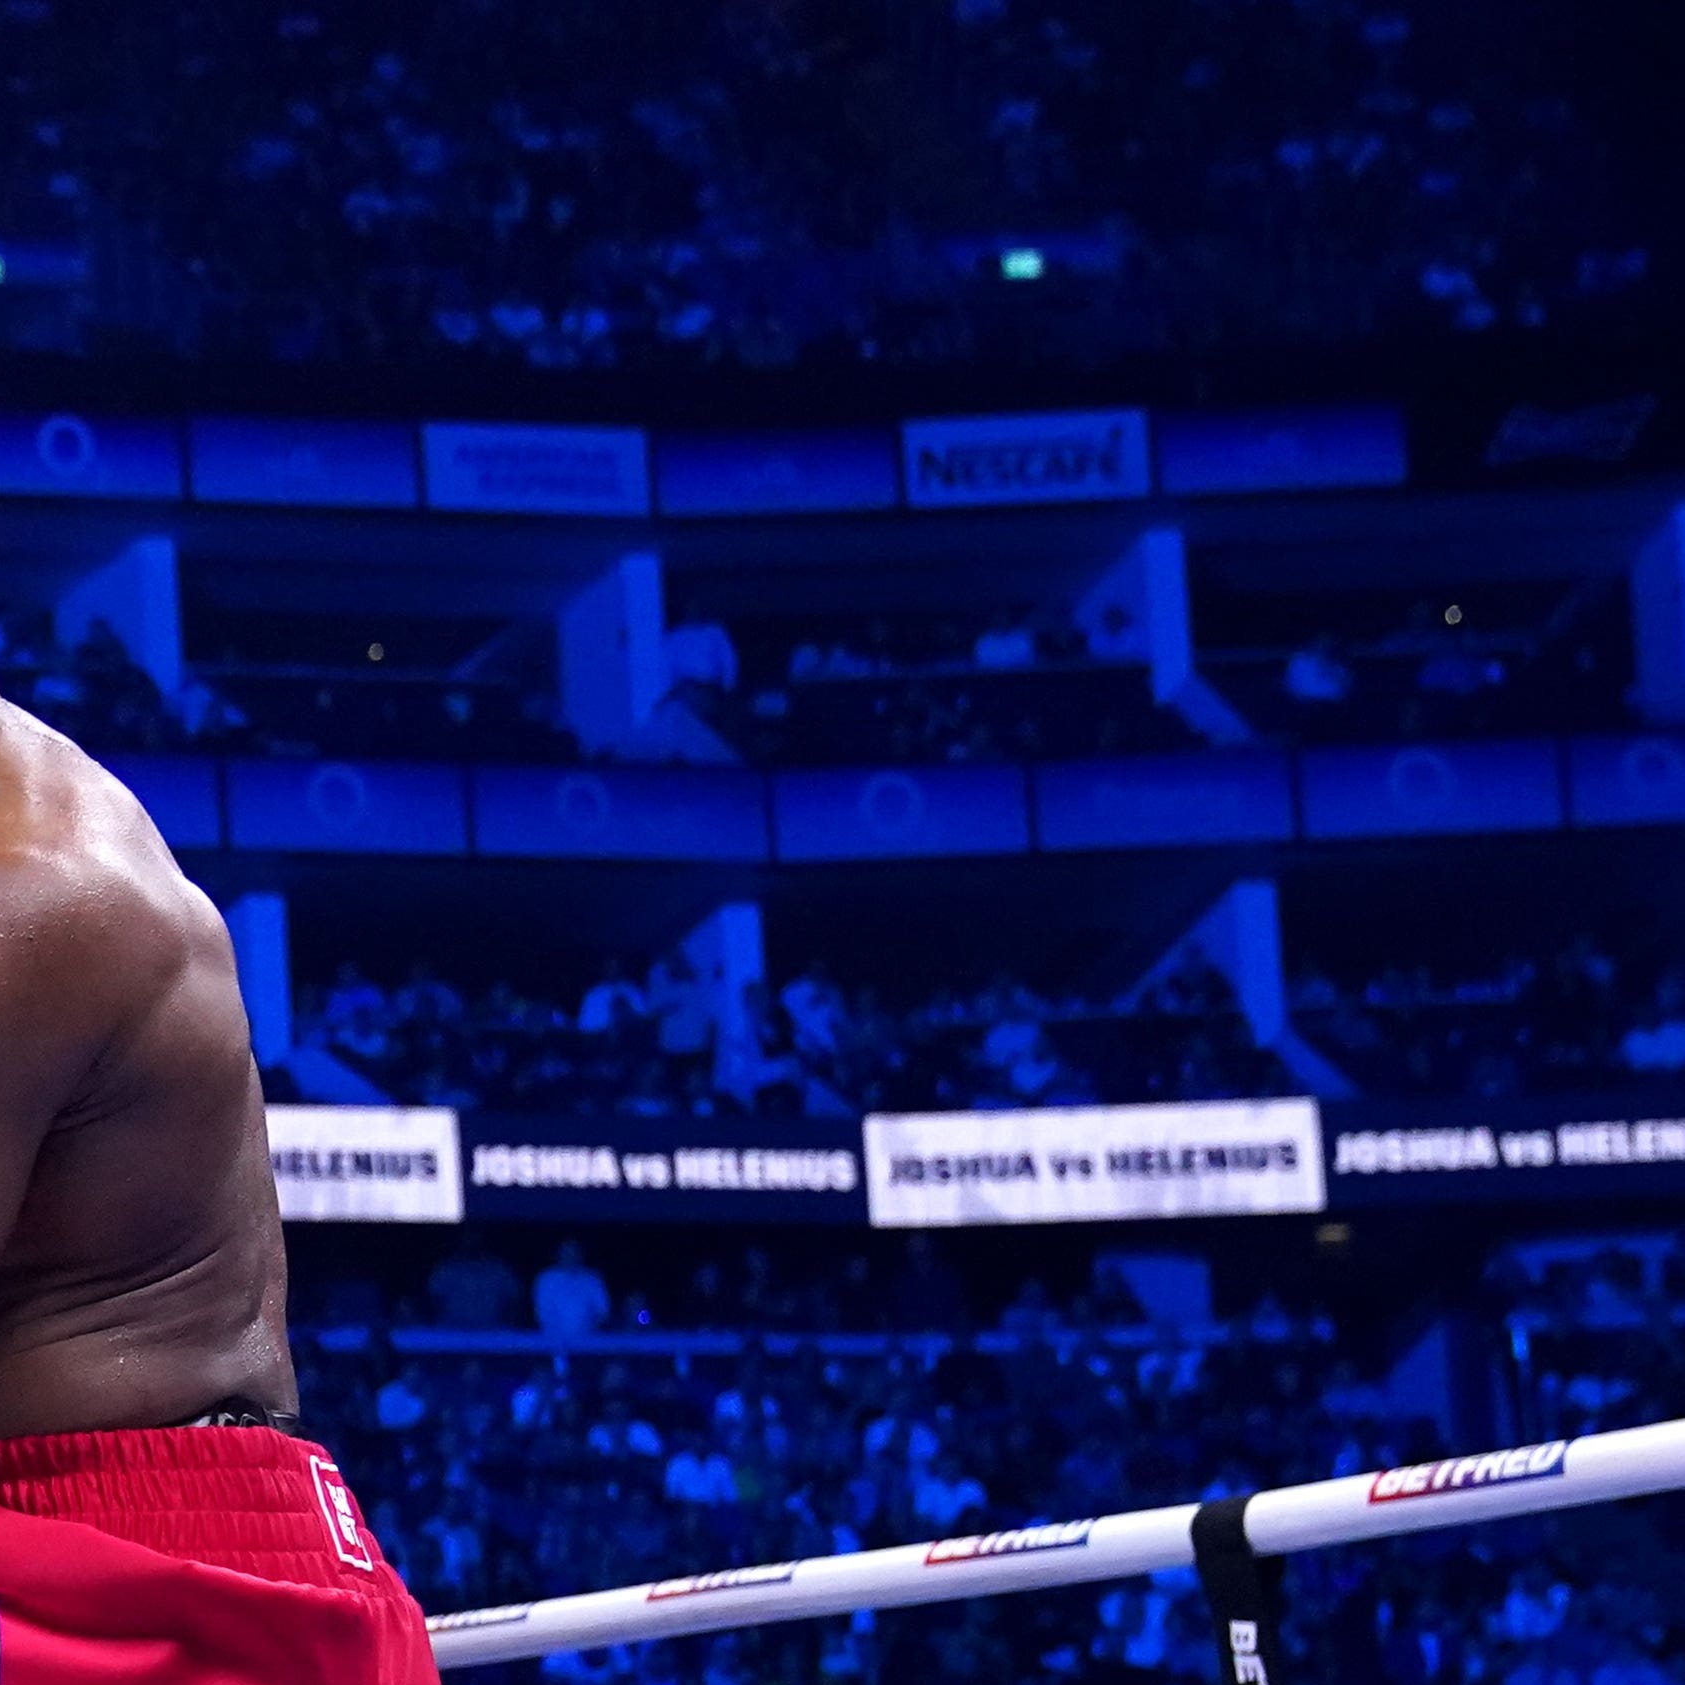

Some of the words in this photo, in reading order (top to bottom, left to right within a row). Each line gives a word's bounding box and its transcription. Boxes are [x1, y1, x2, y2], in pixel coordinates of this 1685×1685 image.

[472, 1146, 621, 1187] JOSHUA
[674, 1148, 856, 1192] HELENIUS
[889, 1150, 1038, 1187] JOSHUA
[1105, 1138, 1298, 1180] HELENIUS
[1335, 1127, 1498, 1173] JOSHUA
